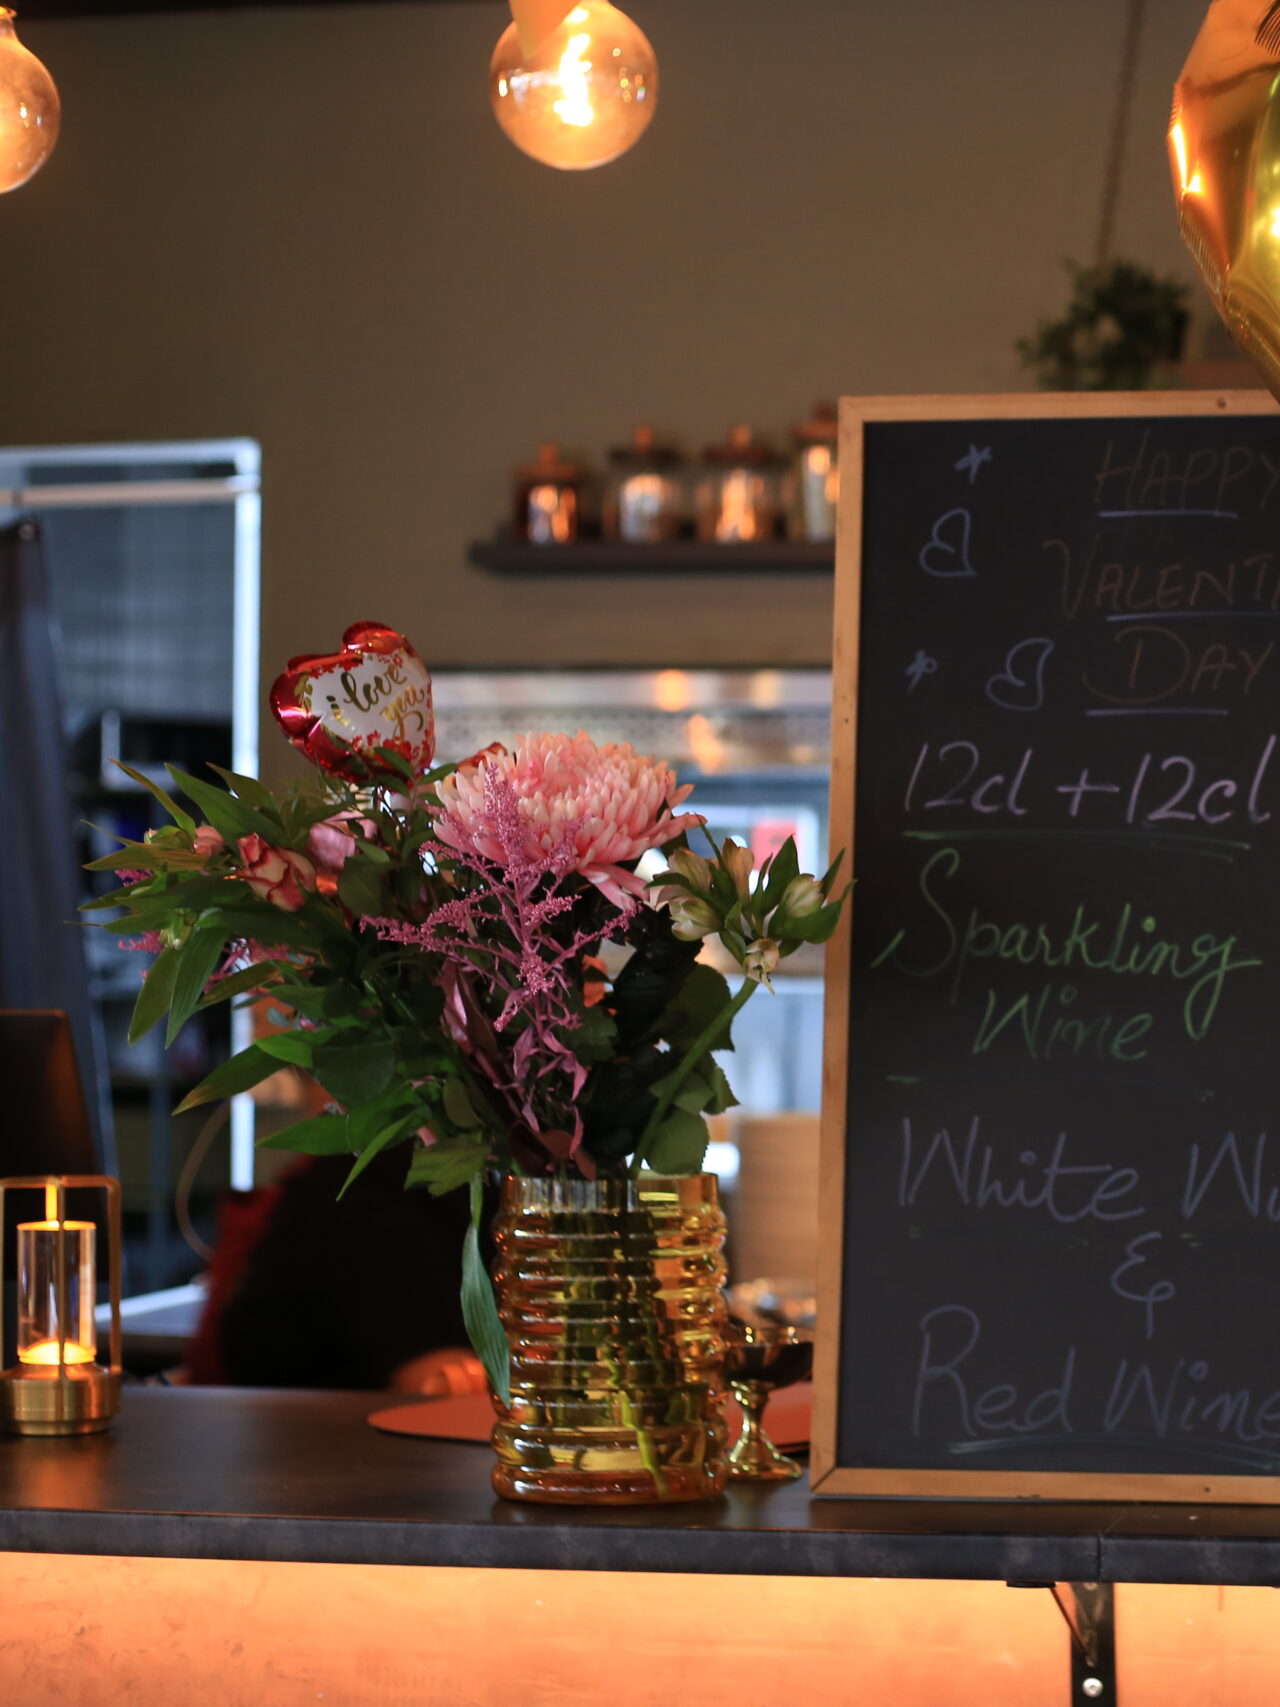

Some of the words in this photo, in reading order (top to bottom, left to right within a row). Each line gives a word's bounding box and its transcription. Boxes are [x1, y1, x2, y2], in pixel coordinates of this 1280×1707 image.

[343, 663, 408, 714] love
[1082, 626, 1276, 704] DAY
[378, 685, 425, 740] you
[871, 847, 1263, 1040] Sparkling
[972, 984, 1155, 1060] Wine
[901, 1115, 1146, 1224] White
[912, 1304, 1074, 1437] Red
